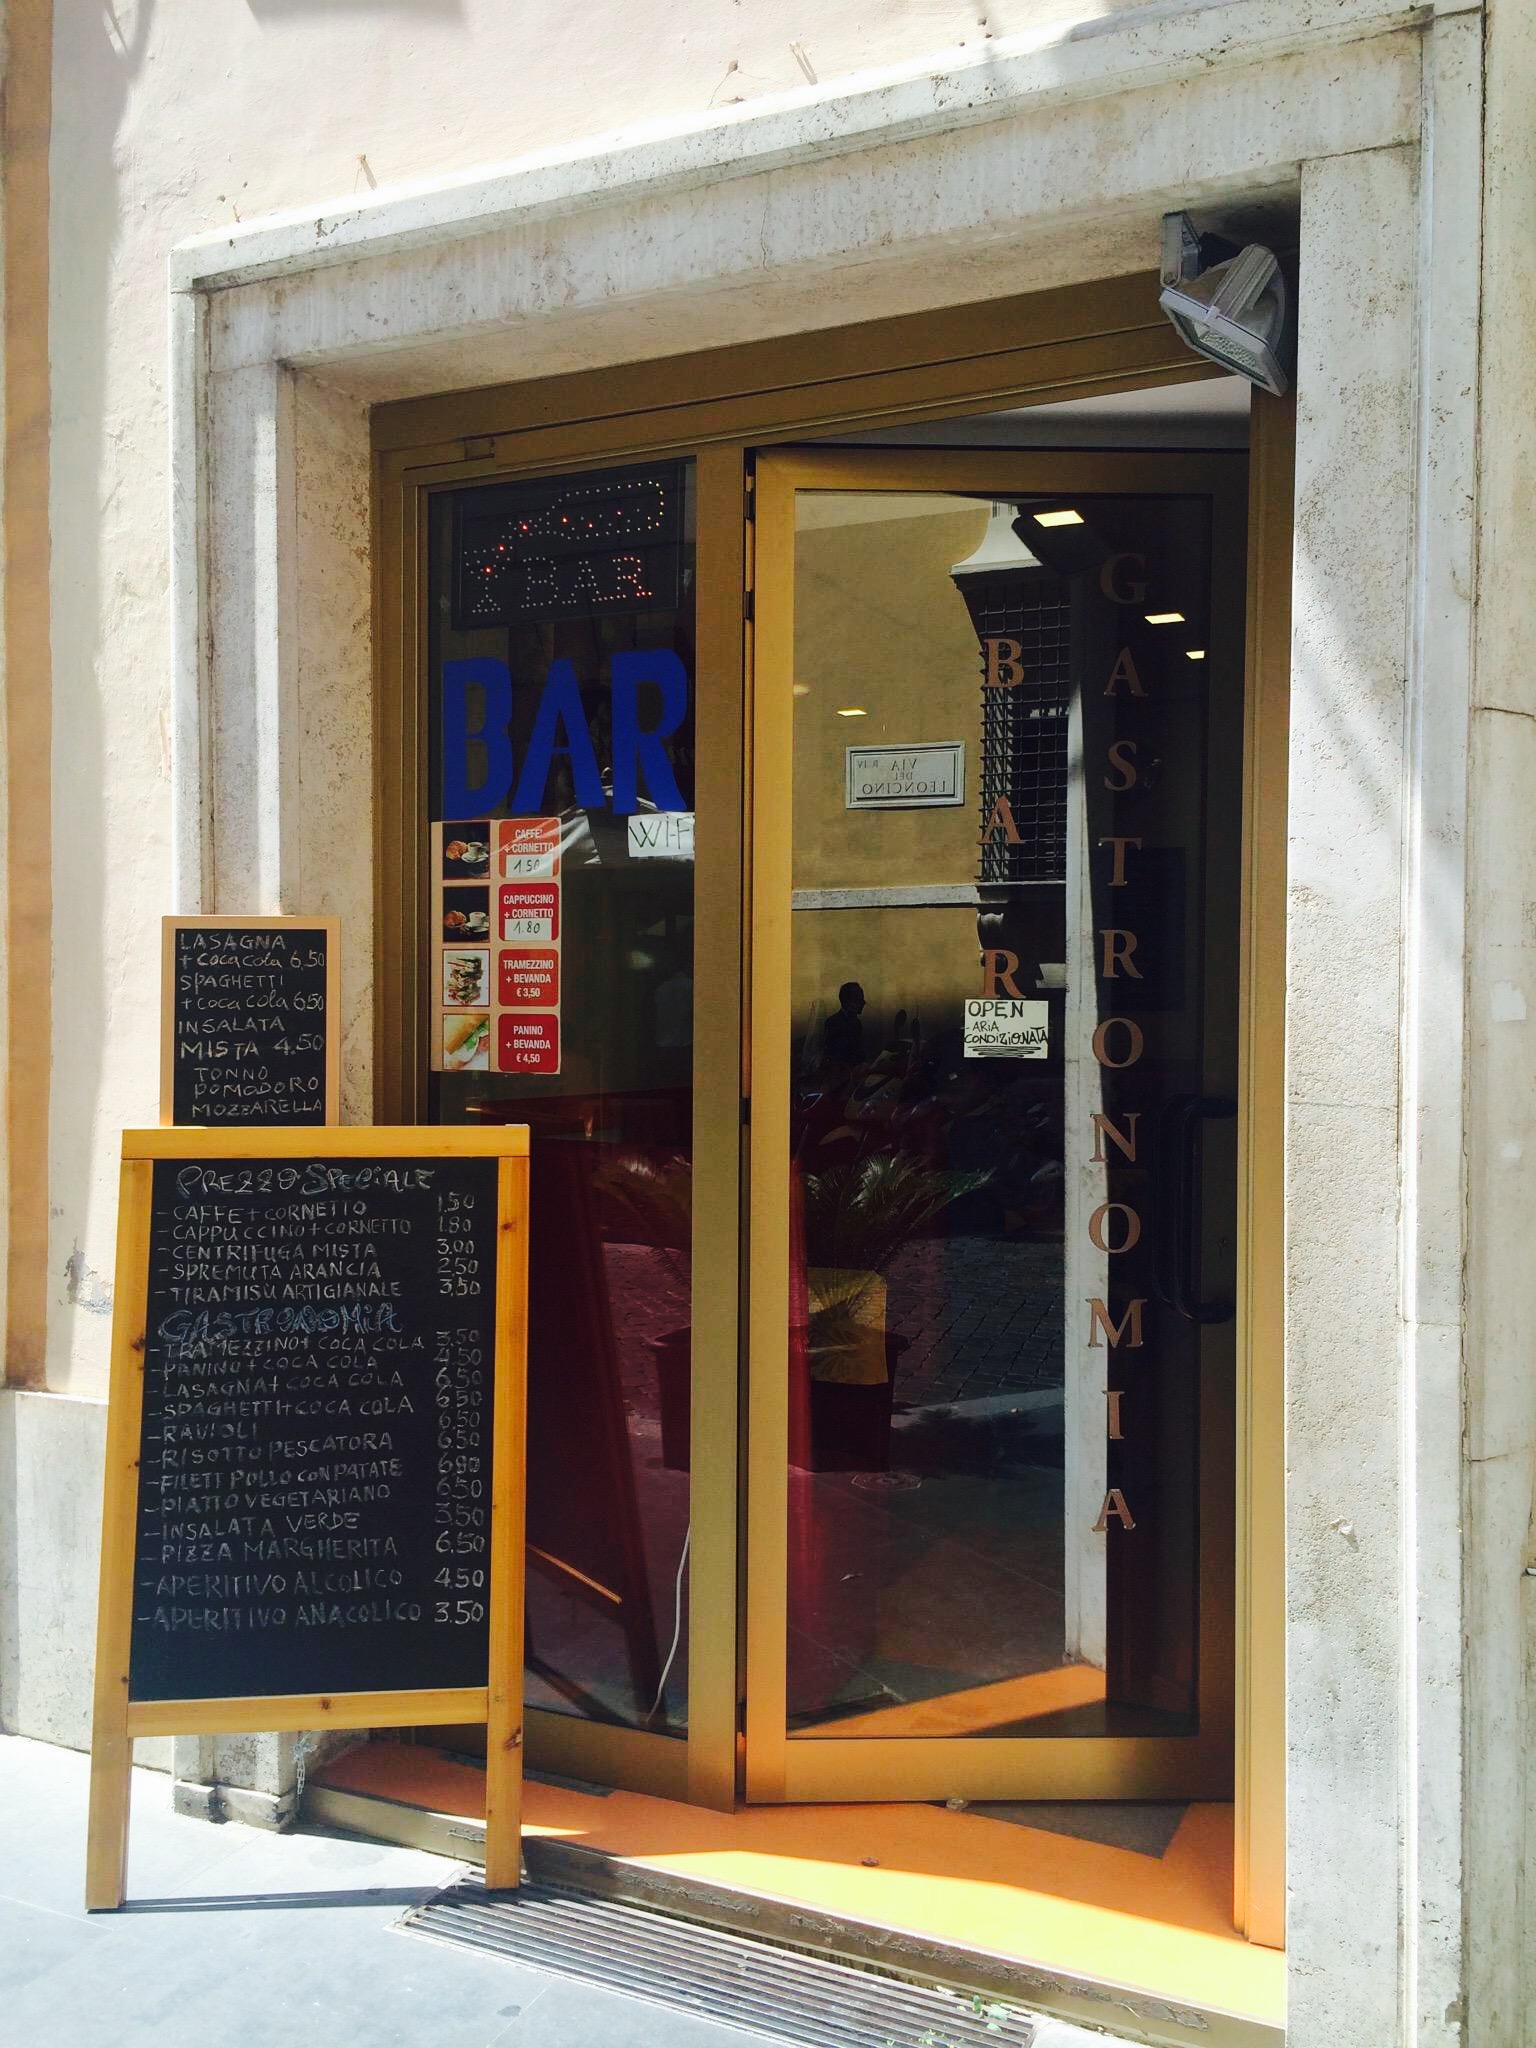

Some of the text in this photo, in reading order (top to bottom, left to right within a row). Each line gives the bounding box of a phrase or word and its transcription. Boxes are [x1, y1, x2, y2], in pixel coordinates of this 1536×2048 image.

[521, 556, 653, 609] BAR
[442, 649, 687, 821] BAR
[980, 638, 1026, 999] BAR
[512, 842, 554, 853] CORNETTO
[503, 894, 554, 905] CAPPUCCINO
[512, 908, 554, 918] CORNETTO
[179, 933, 286, 951] LASAGNA
[503, 959, 554, 970] TRAMEZZINO
[180, 972, 284, 995] SPAGHETTI
[513, 973, 551, 984] BEVANDA
[968, 1001, 1024, 1018] OPEN
[178, 1016, 286, 1036] INSALATA
[513, 1025, 543, 1035] PANINO
[180, 1033, 324, 1061] MISTA 4.50
[513, 1039, 551, 1050] BEVANDA
[1086, 552, 1148, 1531] GASTRONOMIA
[194, 1066, 268, 1082] TONNO
[194, 1077, 319, 1099] POMODORO
[192, 1099, 322, 1118] MOZZARELLA
[173, 1205, 245, 1224] CAFFE
[173, 1225, 305, 1243] CAPPUCCINO
[325, 1218, 412, 1235] CORNETTO
[172, 1238, 475, 1263] CENTRIFUGA MISTA 3.00
[172, 1263, 282, 1281] SPREMUTA
[290, 1261, 381, 1279] ARANCIA
[282, 1281, 403, 1301] ARTIGIANALE
[318, 1336, 367, 1354] COCA
[372, 1336, 425, 1351] COLA
[163, 1359, 241, 1381] PANINO
[263, 1354, 318, 1370] COCA
[327, 1355, 378, 1369] COLA
[162, 1377, 268, 1399] LASAGNA
[286, 1373, 339, 1390] COCA
[349, 1370, 404, 1387] COLA
[359, 1395, 414, 1416] COLA
[163, 1421, 257, 1445] RAVIOLI
[161, 1446, 262, 1469] RISOTTO
[268, 1432, 393, 1461] PESCATORA
[230, 1469, 292, 1490] POLLO
[334, 1458, 403, 1481] PATATE
[161, 1494, 239, 1516] PIATTO
[244, 1484, 391, 1508] VEGETARIANO
[162, 1517, 275, 1540] INSALATA
[286, 1512, 360, 1533] VERDE
[162, 1543, 232, 1564] PIZZA
[244, 1536, 398, 1562] MARGHERITA
[156, 1574, 286, 1598] APERITIVO
[294, 1568, 402, 1595] ALCOLICO
